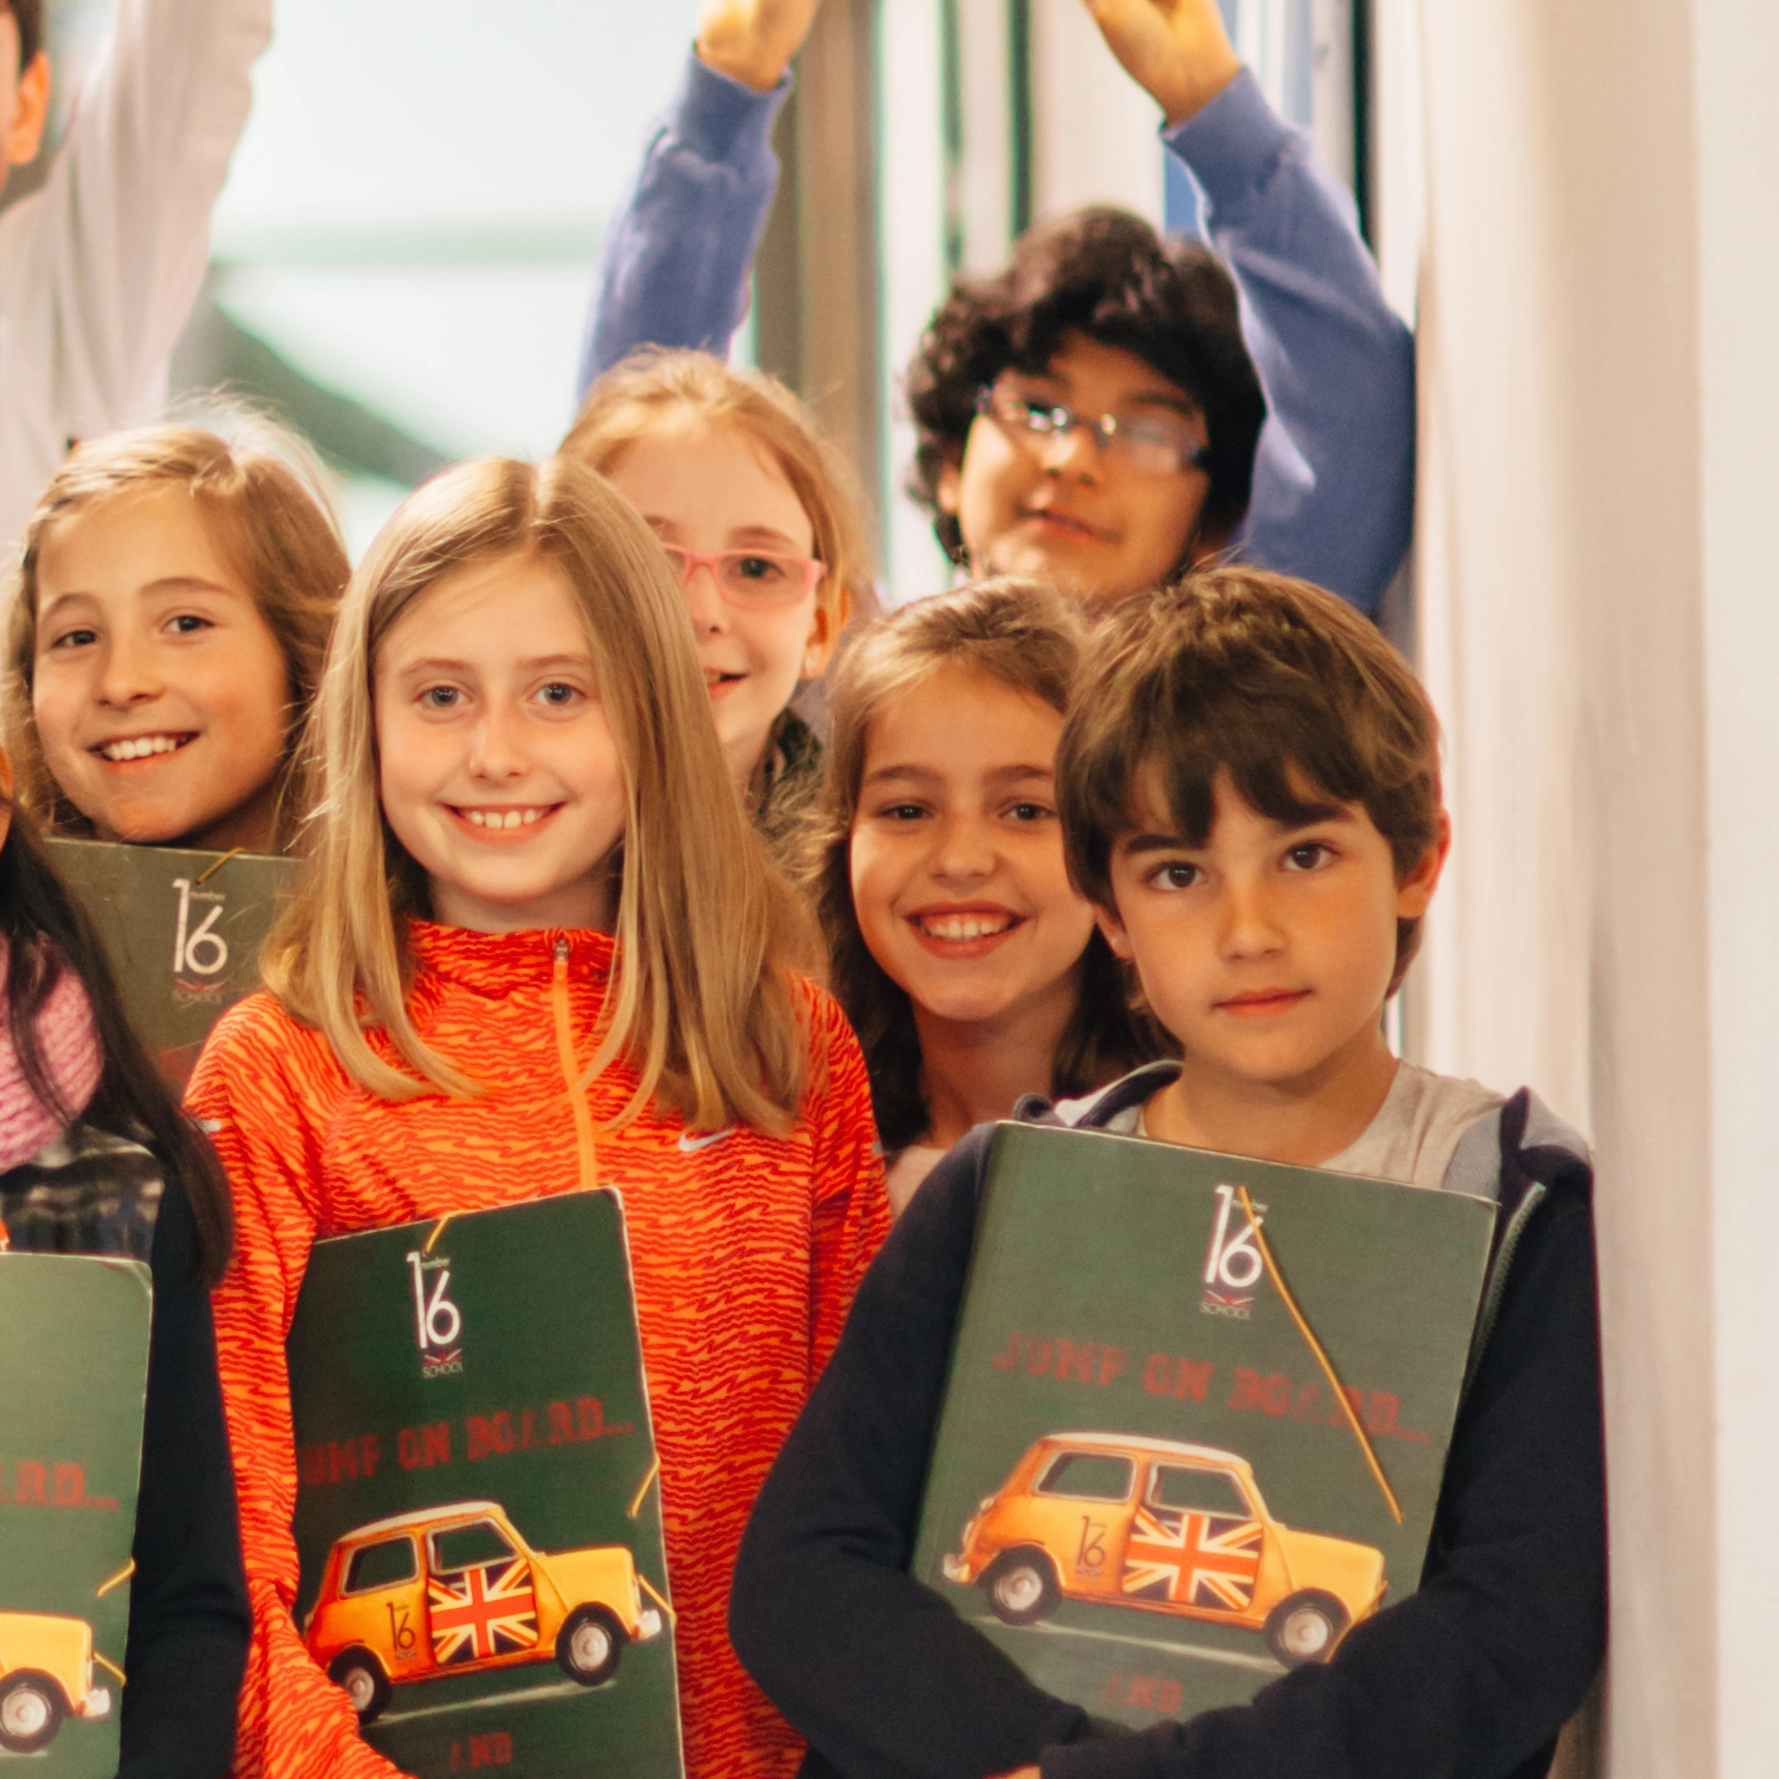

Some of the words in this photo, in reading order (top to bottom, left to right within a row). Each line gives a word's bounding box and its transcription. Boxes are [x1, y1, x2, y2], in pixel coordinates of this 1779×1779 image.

[172, 878, 228, 975] 16
[1206, 1184, 1264, 1287] 16
[406, 1251, 460, 1349] 16
[992, 1330, 1128, 1388] JUMP
[1142, 1352, 1214, 1402] ON
[397, 1422, 451, 1470] ON
[386, 1602, 416, 1652] 16
[1099, 1671, 1184, 1713] AND
[449, 1732, 514, 1773] AND
